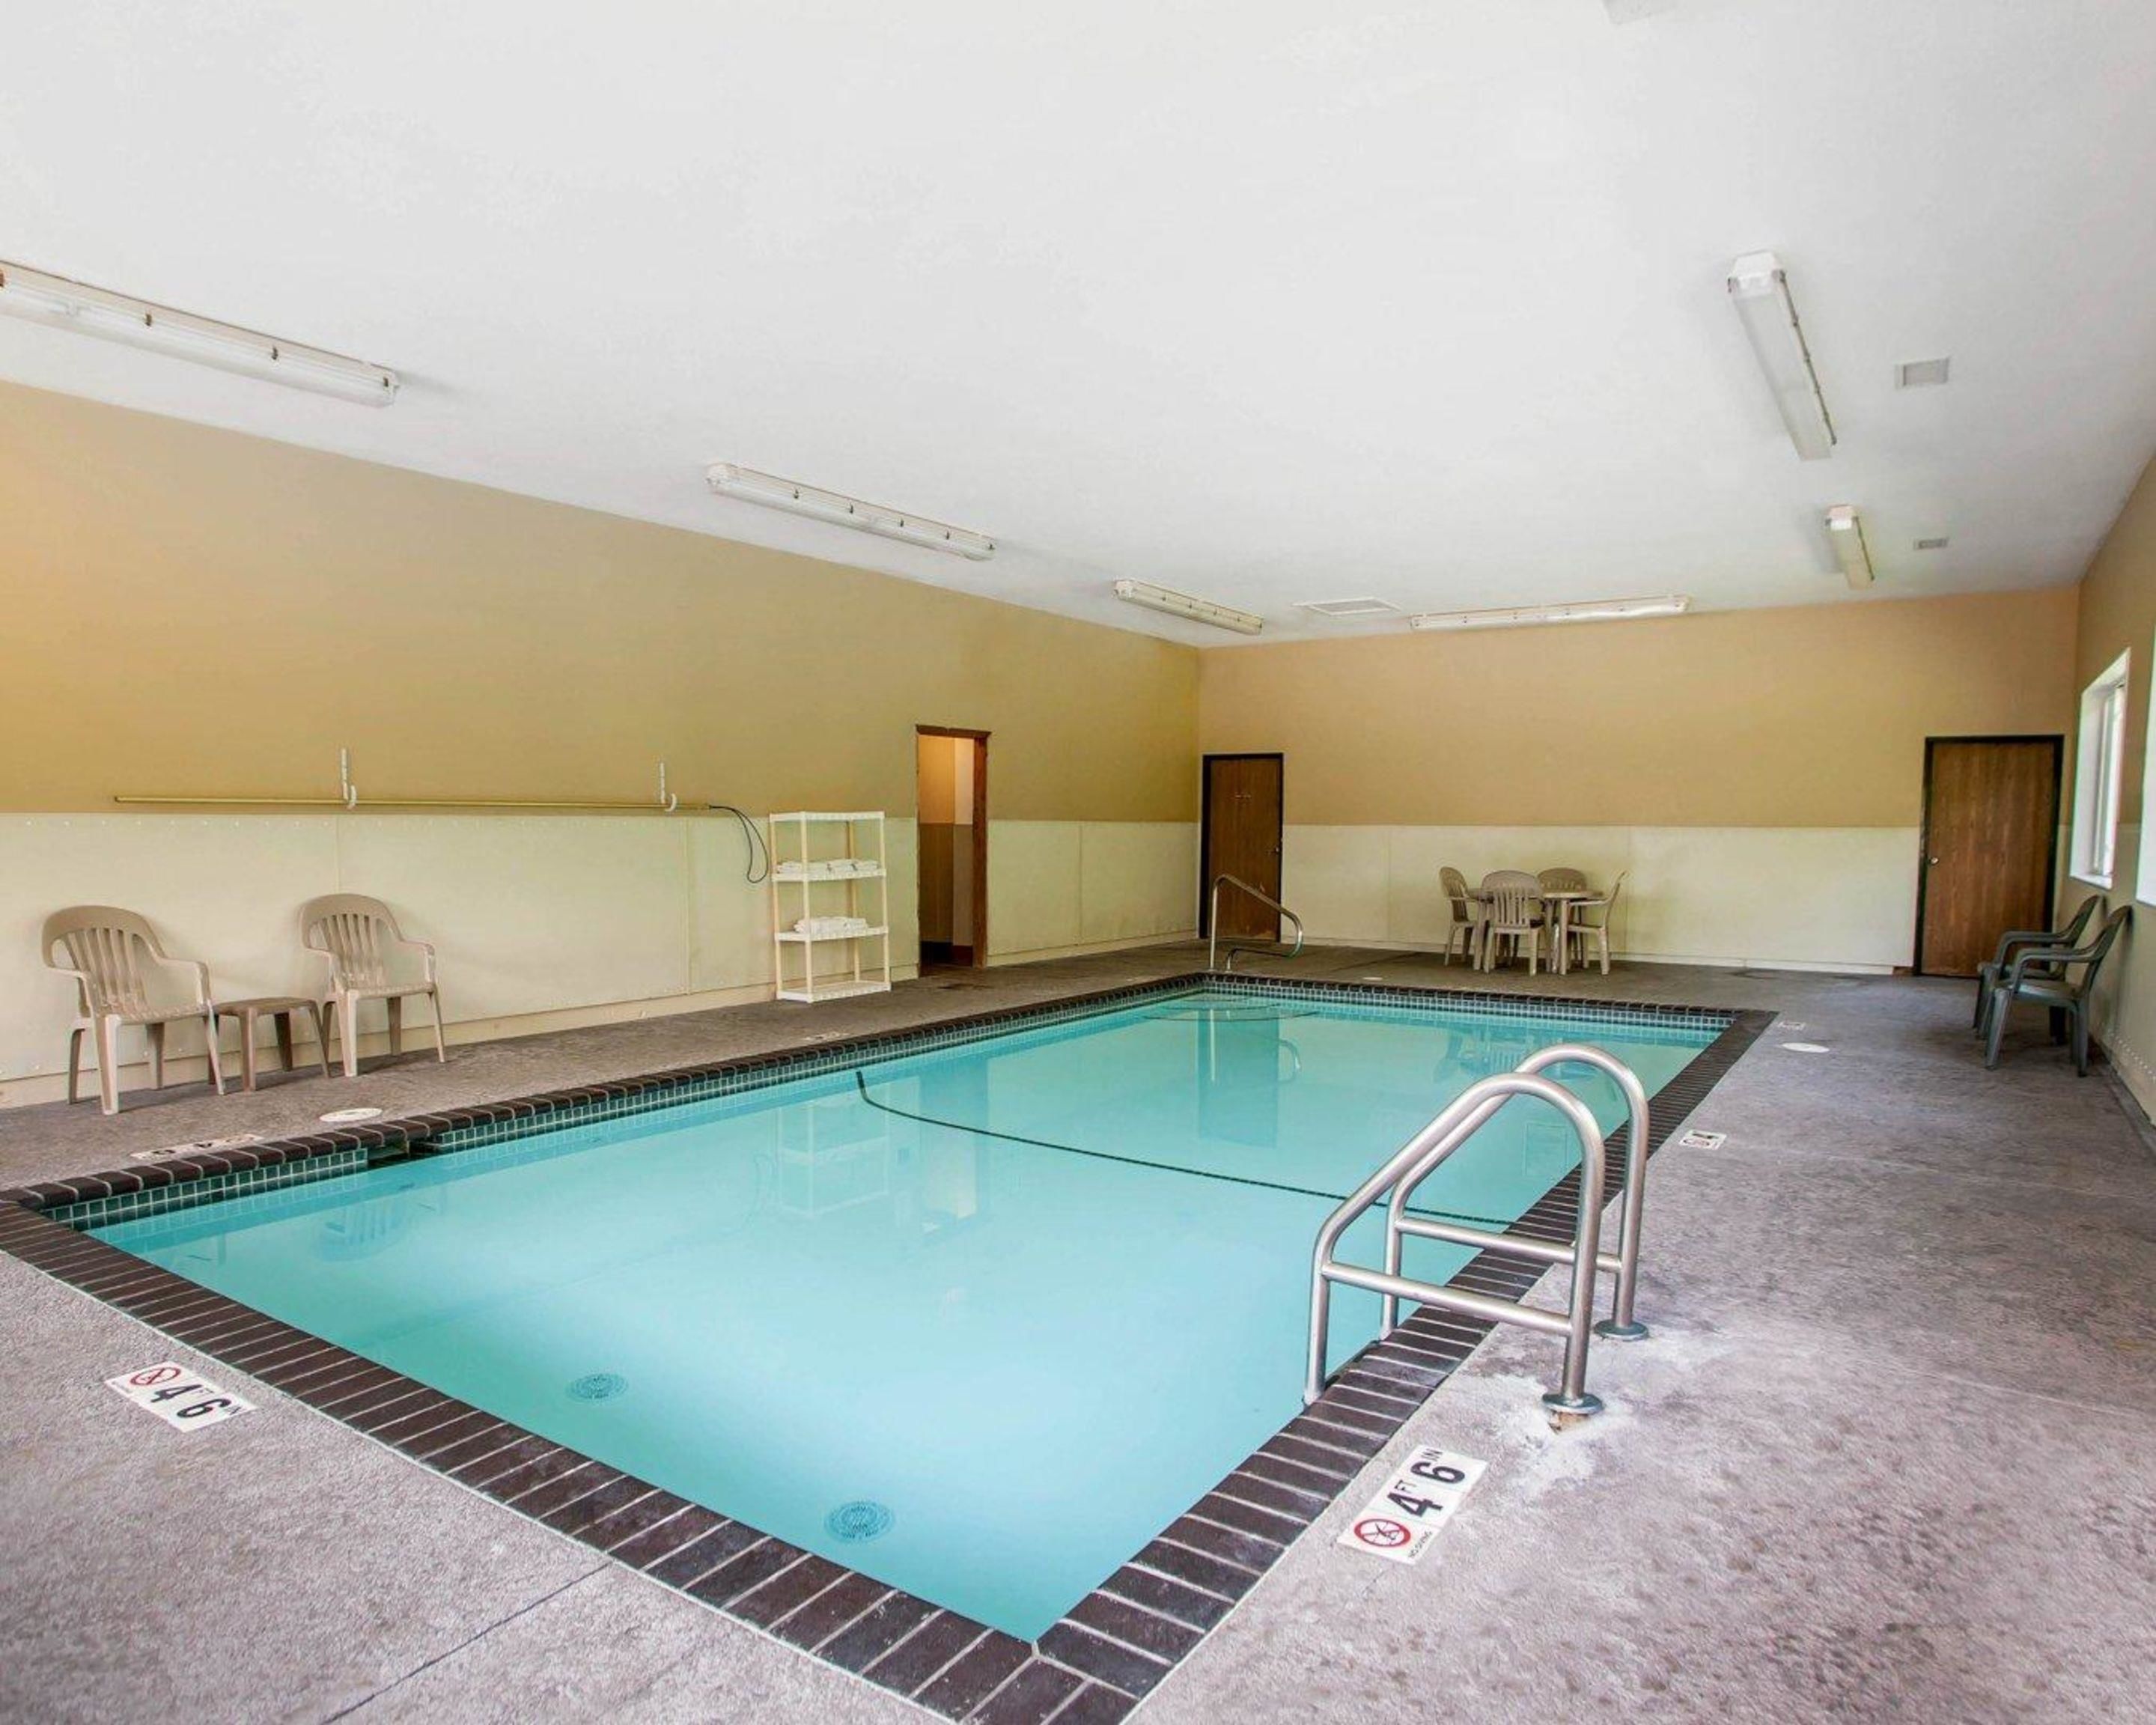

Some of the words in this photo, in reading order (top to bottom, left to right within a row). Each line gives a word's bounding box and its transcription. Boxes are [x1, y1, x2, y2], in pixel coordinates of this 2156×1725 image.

[150, 1384, 203, 1403] 4
[177, 1399, 233, 1418] 6
[1410, 1461, 1466, 1484] 6
[1394, 1479, 1417, 1494] FT
[1387, 1491, 1443, 1518] 4
